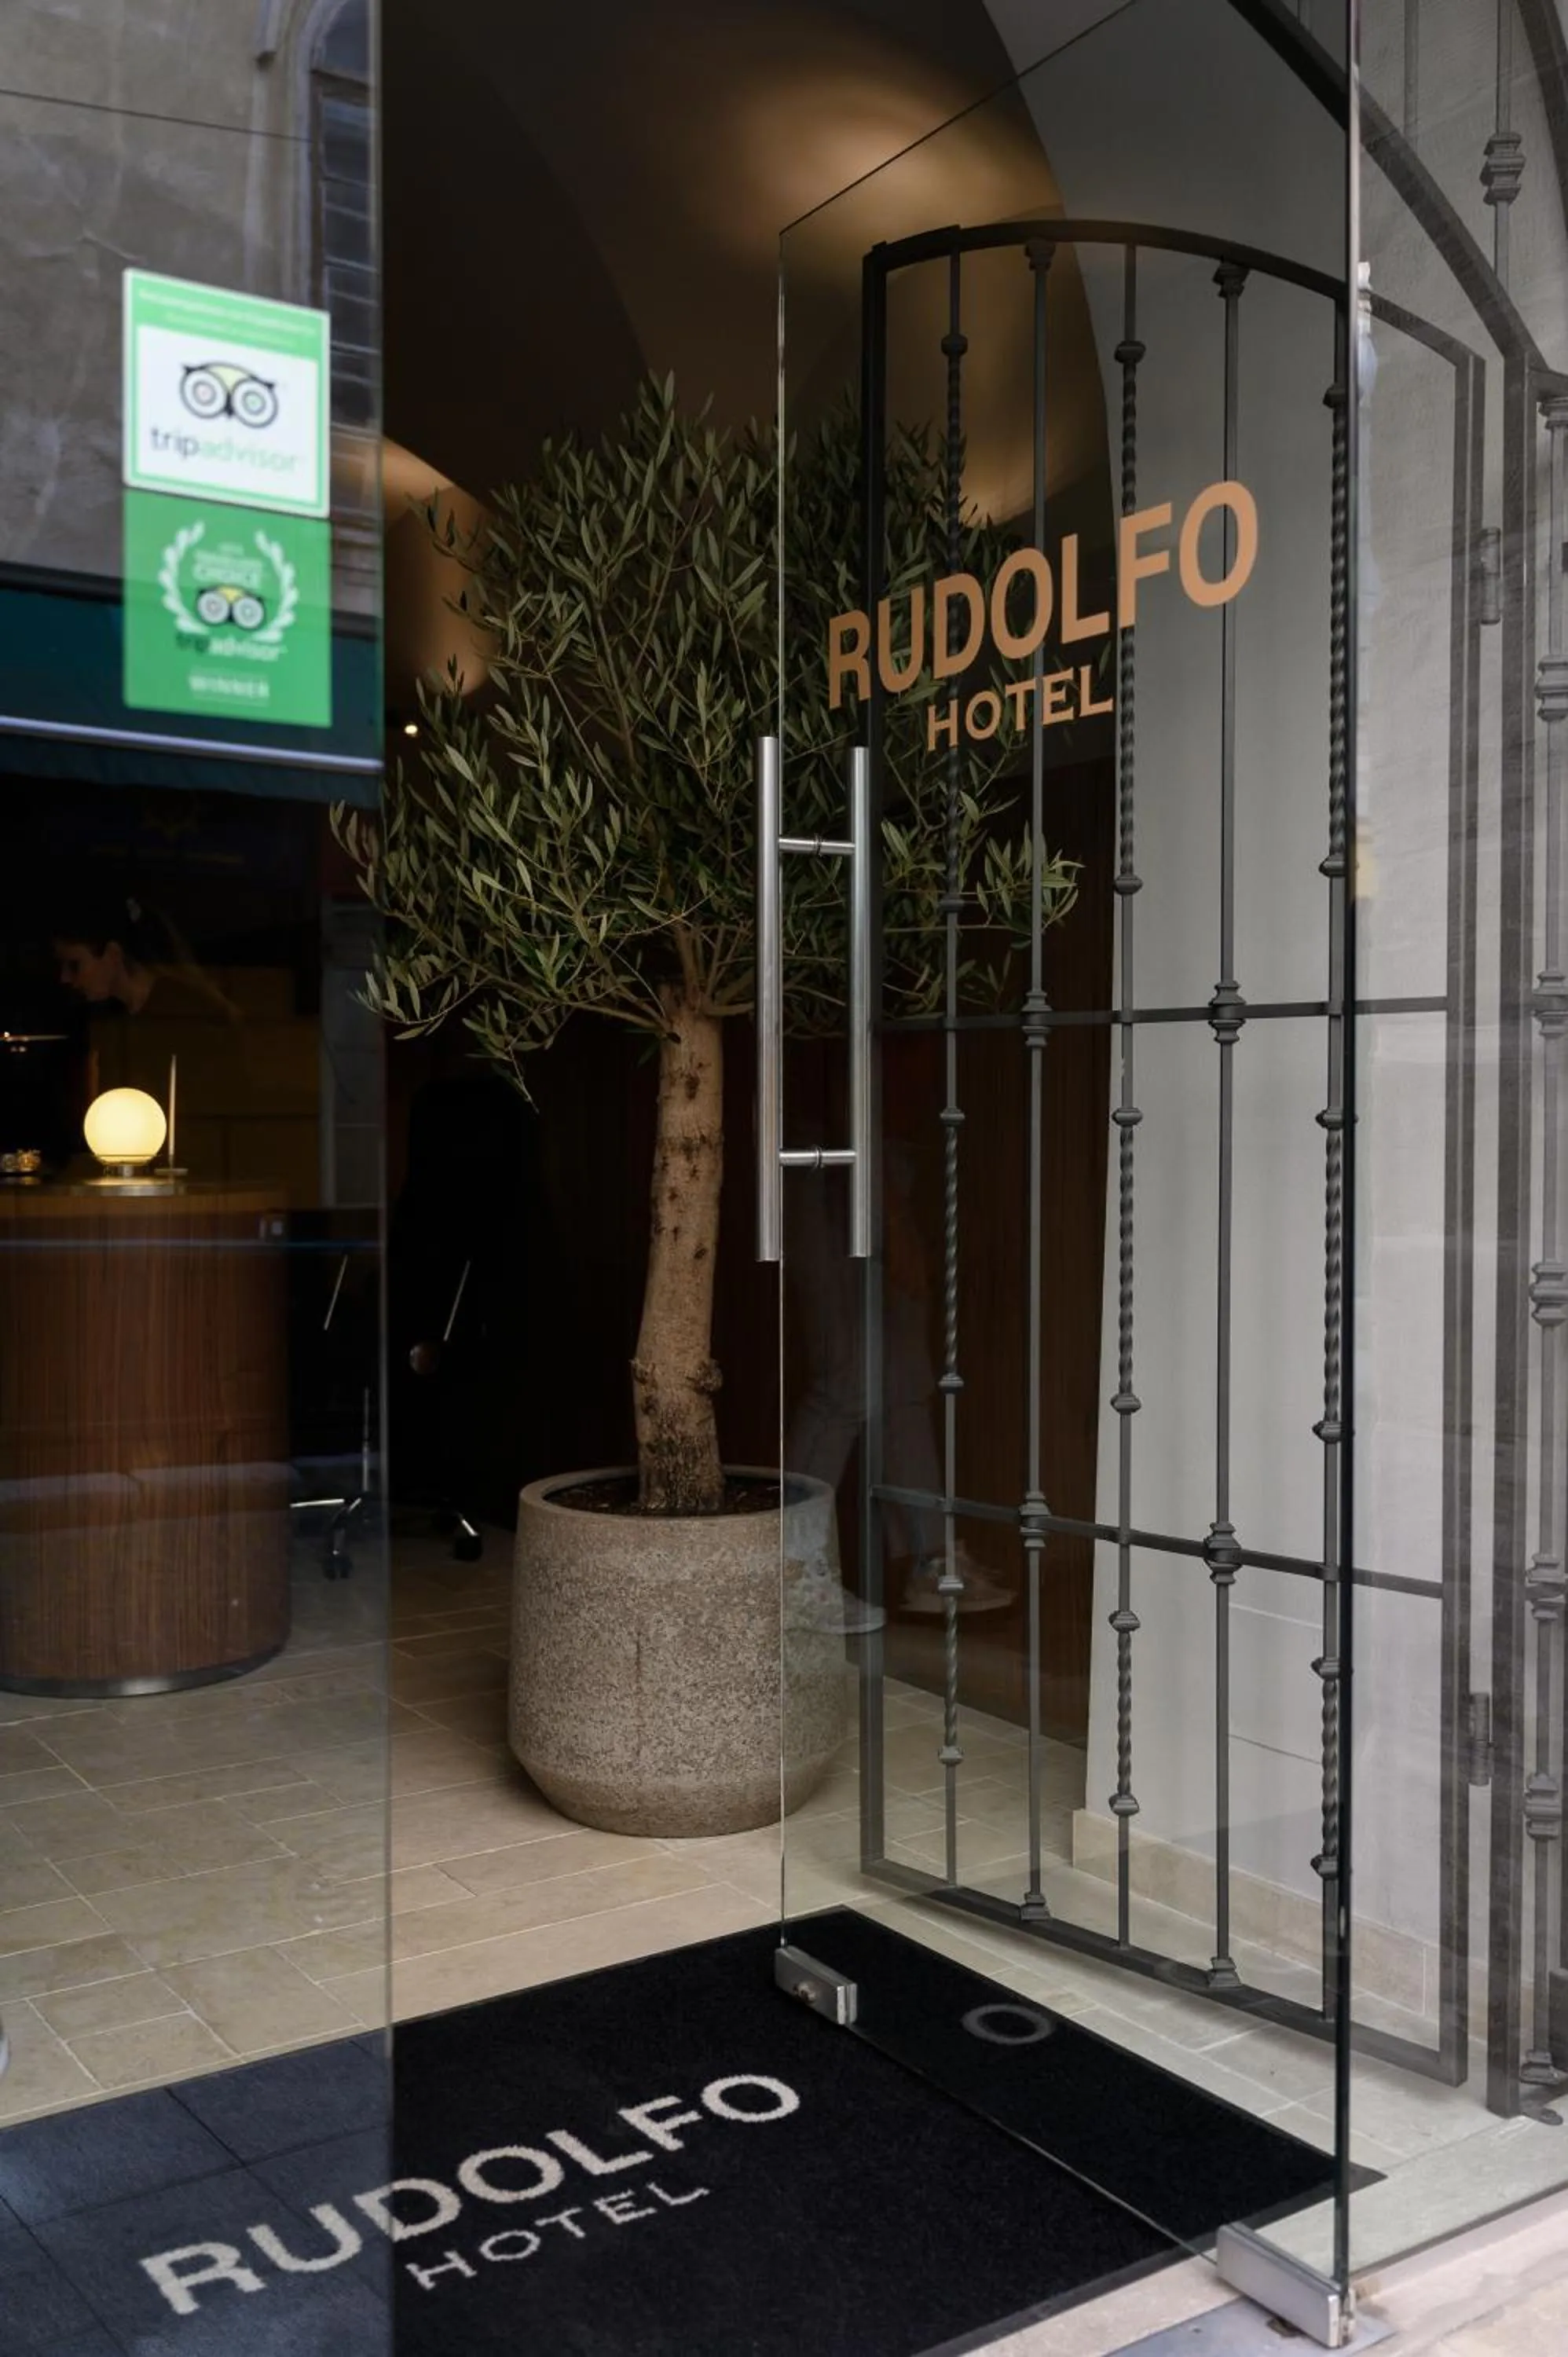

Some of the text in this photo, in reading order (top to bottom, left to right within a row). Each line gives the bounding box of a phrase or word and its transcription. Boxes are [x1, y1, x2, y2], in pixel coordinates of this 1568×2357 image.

[151, 426, 299, 472] tripadvisor
[829, 480, 1258, 709] RUDOLFO
[188, 674, 270, 699] WINNER
[926, 665, 1114, 752] HOTEL
[140, 2073, 800, 2315] RUDOLFO
[405, 2181, 709, 2291] HOTEL
